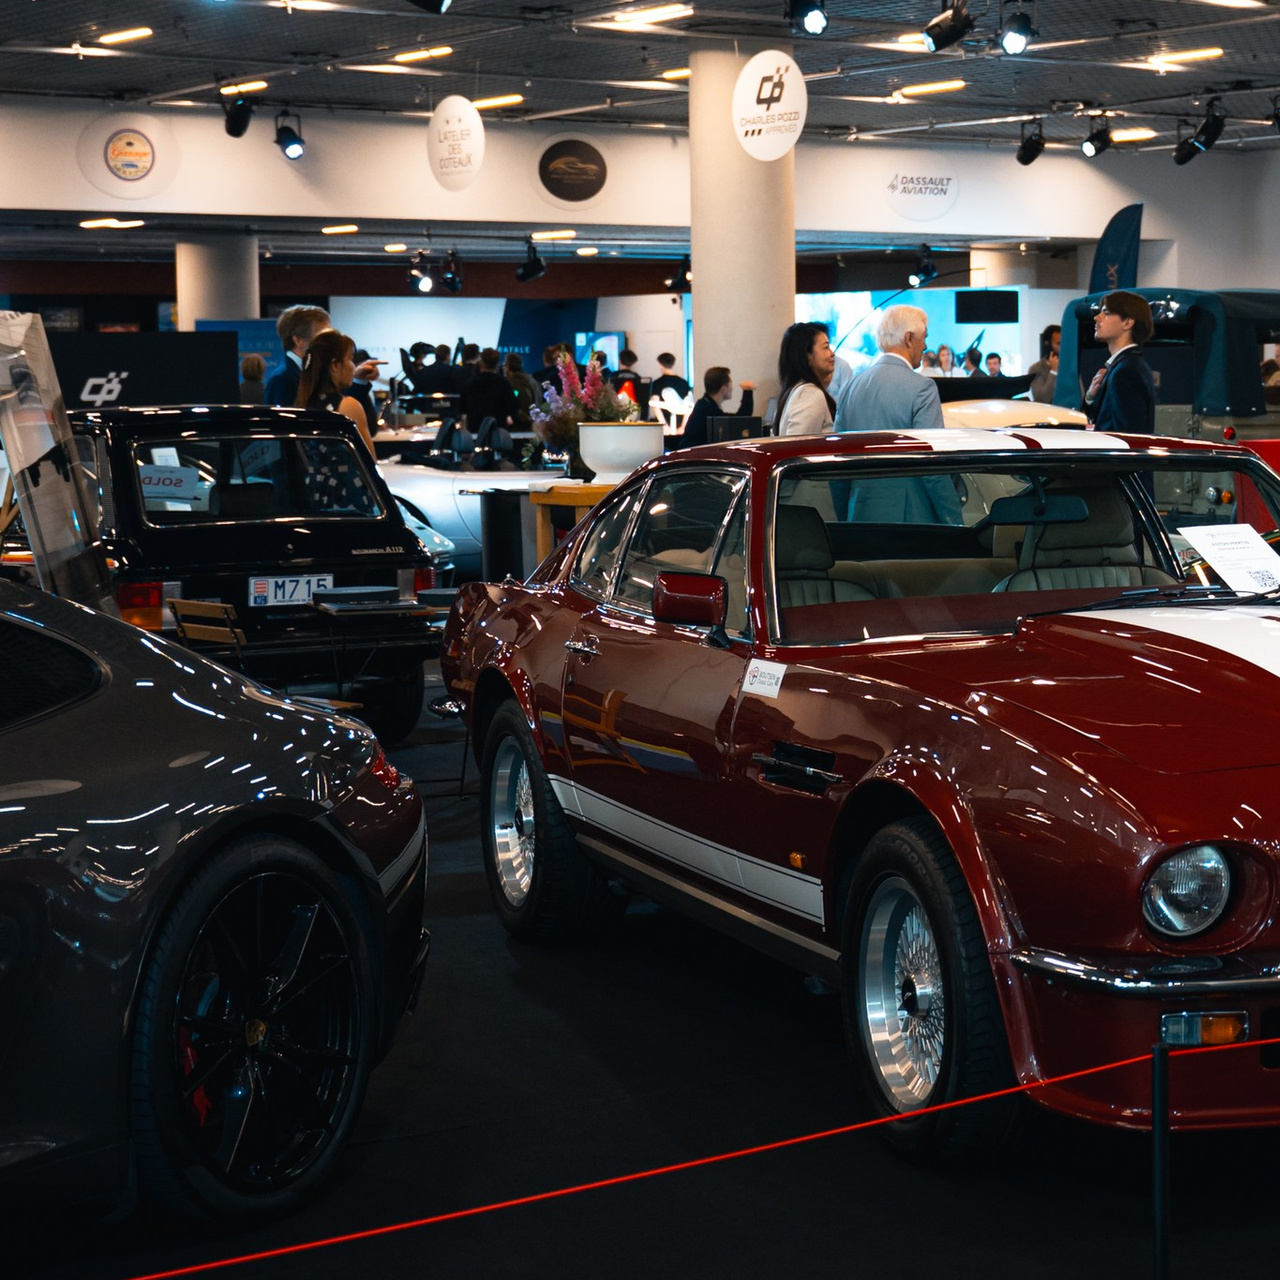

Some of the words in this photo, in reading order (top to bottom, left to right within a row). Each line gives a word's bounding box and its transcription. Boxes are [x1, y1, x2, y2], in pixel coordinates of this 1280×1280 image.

[740, 114, 776, 127] CHARLES
[777, 111, 800, 122] POZZI
[900, 176, 952, 186] DASSAULT
[900, 186, 948, 196] AVIATION
[385, 546, 405, 554] A112
[274, 578, 328, 600] M715
